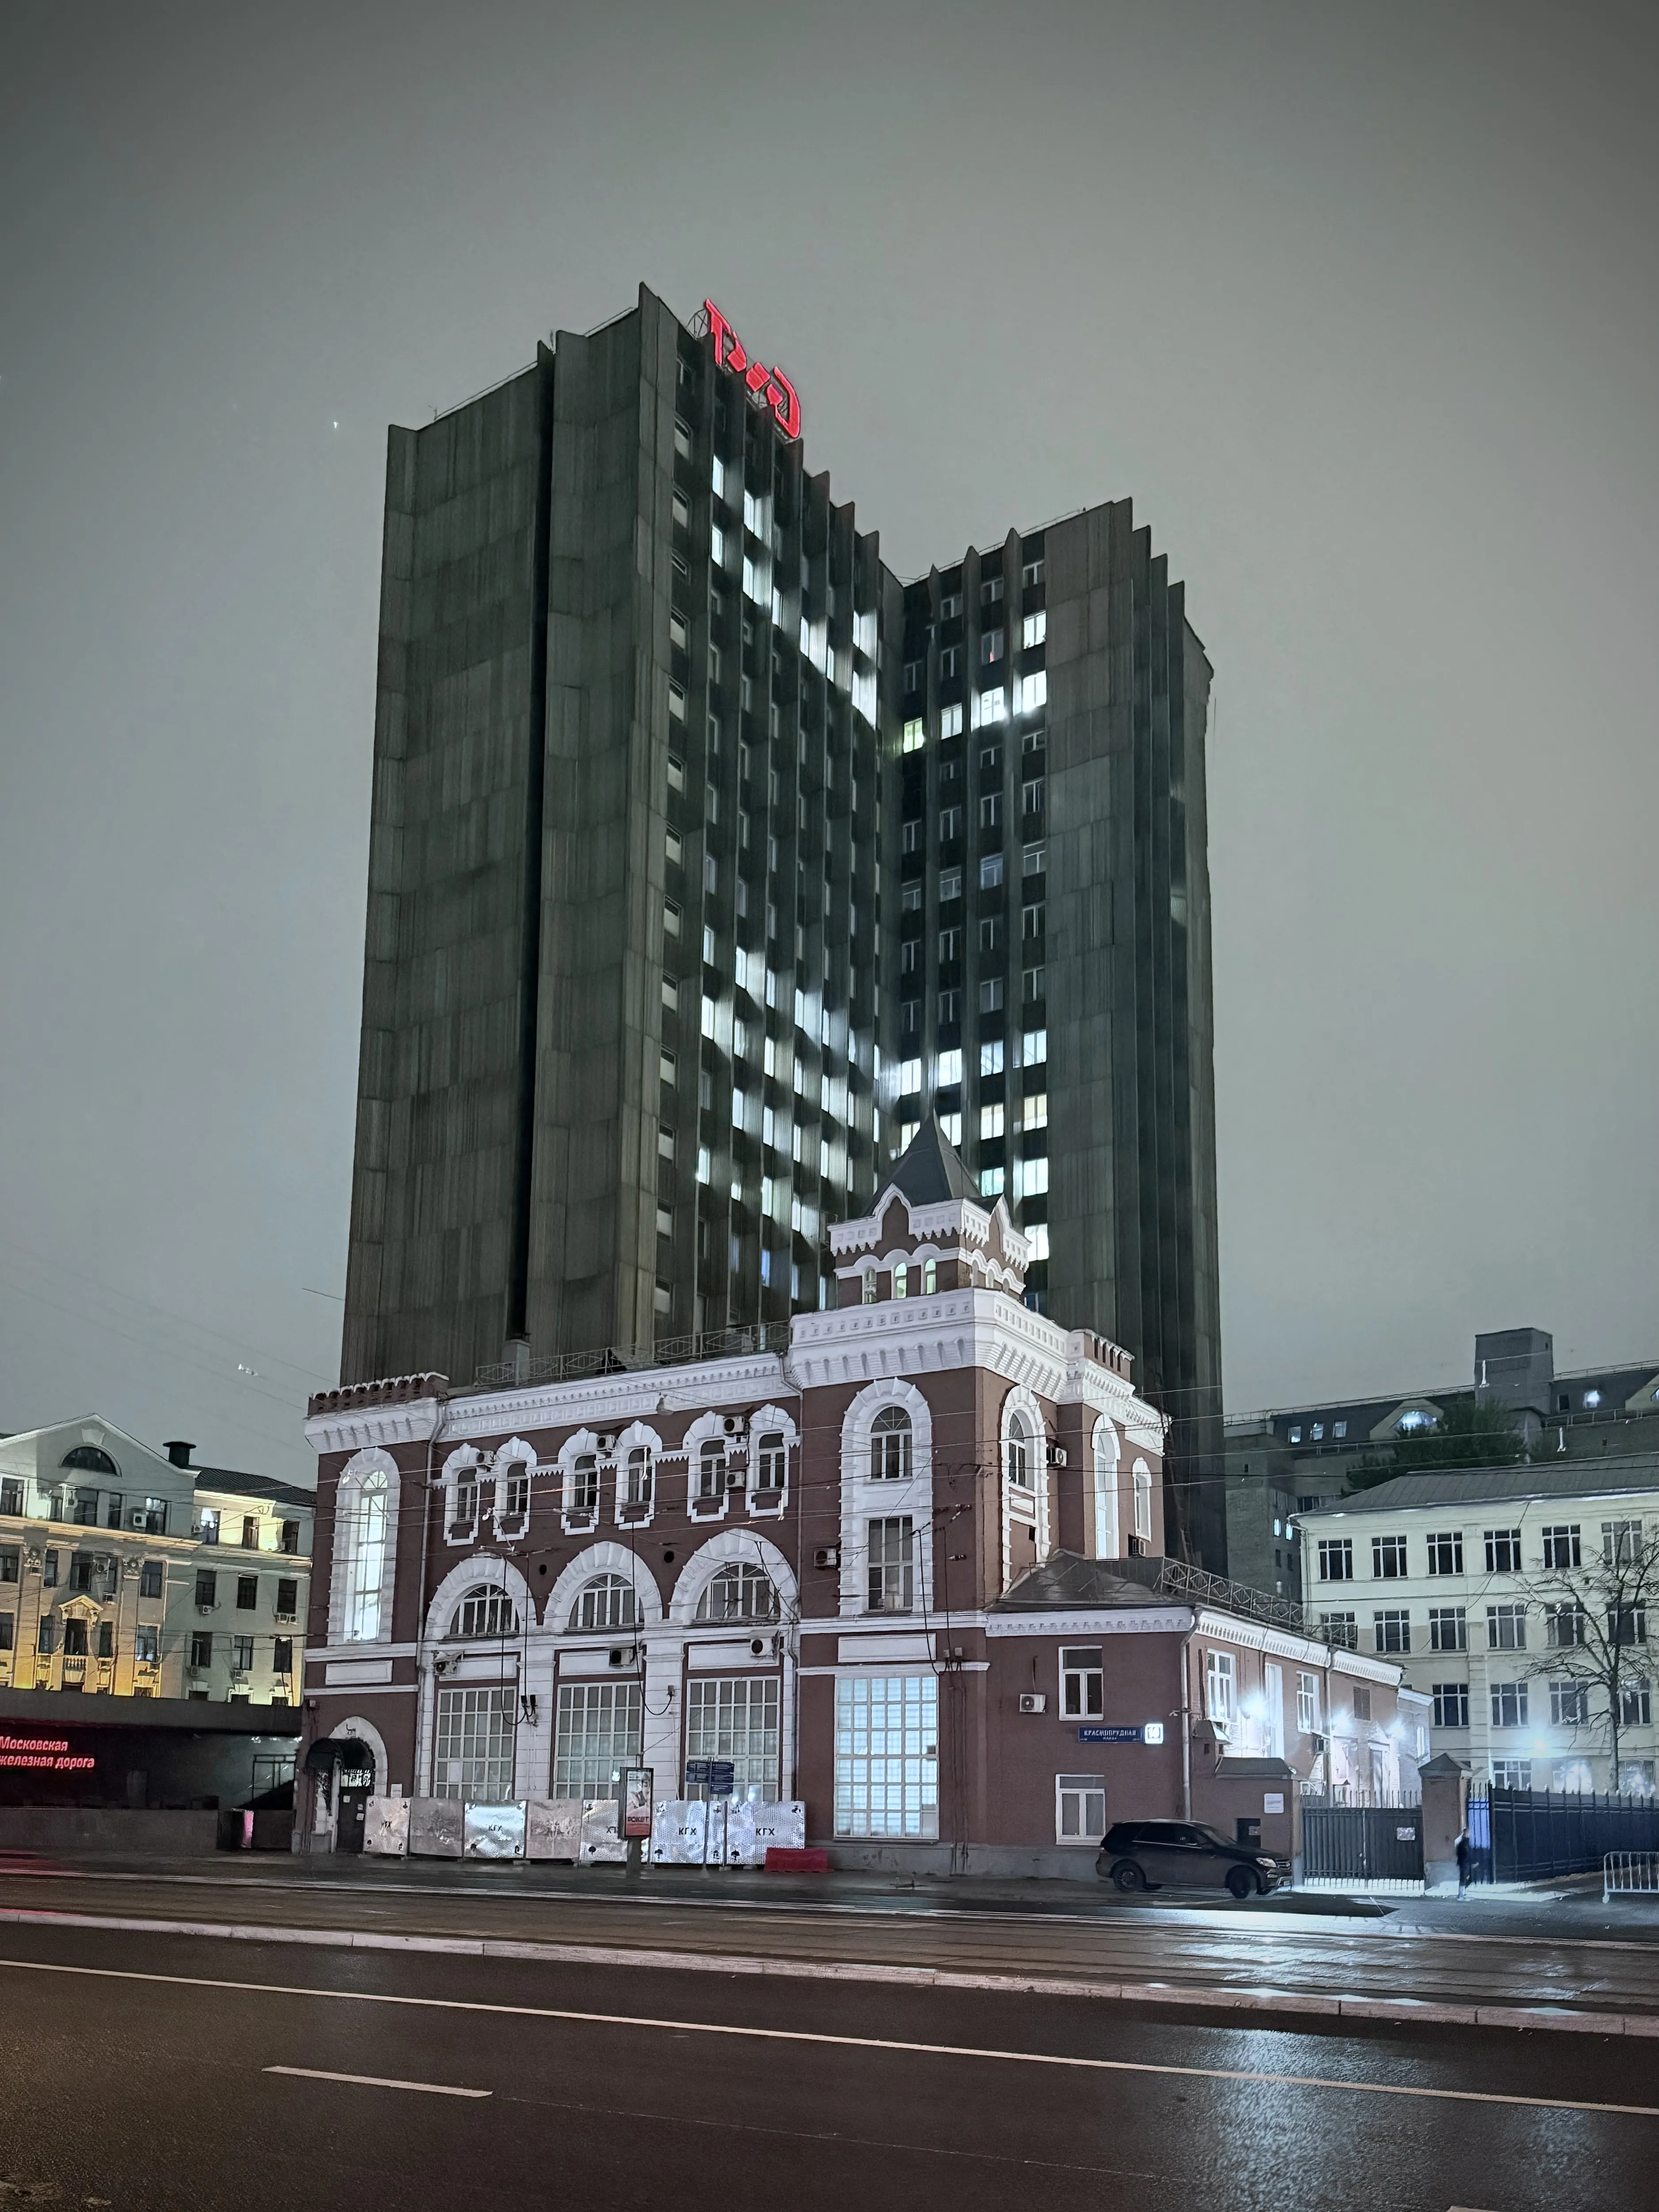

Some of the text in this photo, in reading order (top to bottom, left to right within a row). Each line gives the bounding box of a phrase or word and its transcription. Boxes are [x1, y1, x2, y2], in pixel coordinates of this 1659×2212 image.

[1148, 1727, 1160, 1738] 10
[0, 1735, 68, 1751] Московская
[55, 1757, 95, 1770] дорога
[679, 1827, 697, 1835] КГХ
[756, 1827, 775, 1836] КГХ
